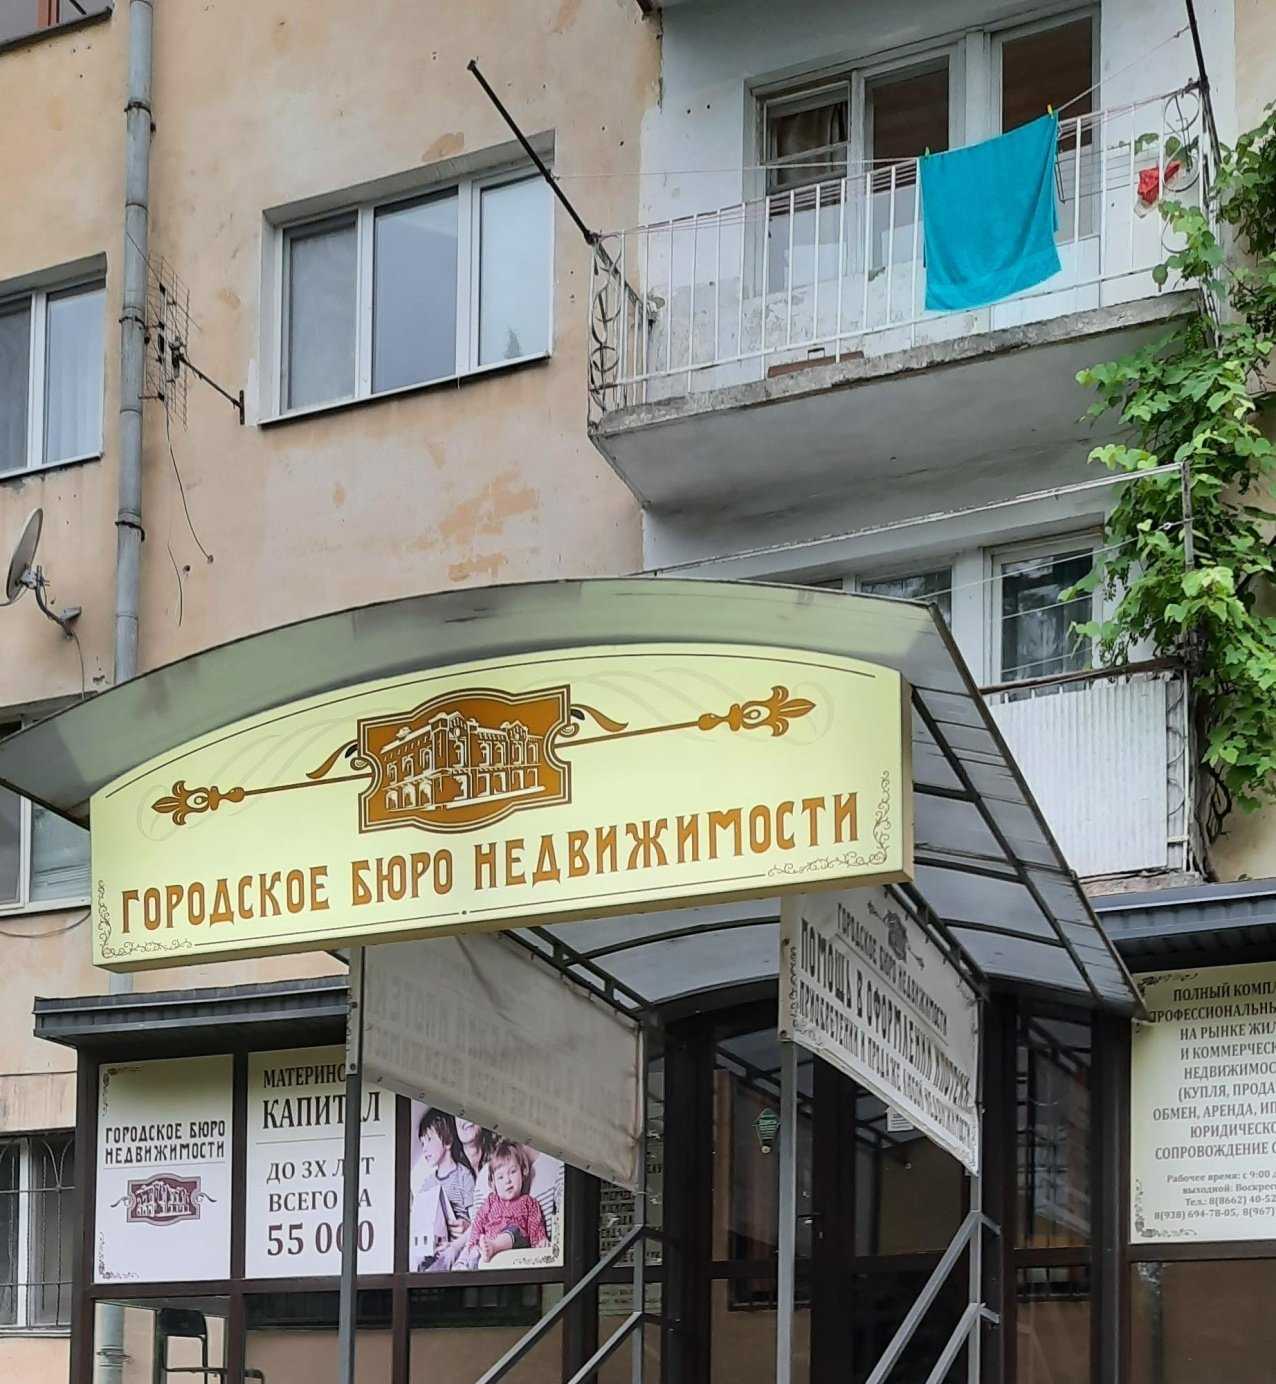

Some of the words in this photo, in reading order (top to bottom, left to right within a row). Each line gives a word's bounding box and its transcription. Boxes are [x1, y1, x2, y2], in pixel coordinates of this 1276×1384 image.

[121, 864, 331, 934] ГОРОДСКОЕ
[351, 847, 453, 906] БЮРО
[473, 791, 860, 890] НЕДВИЖИМОСТИ
[800, 917, 852, 1010] ПОМОЩЬ
[857, 969, 863, 1018] В
[867, 980, 932, 1081] ОФОРМЛЕНИИ
[1173, 982, 1231, 1002] ПОЛНЫЙ
[799, 980, 858, 1058] ПРИОБРЕТЕНИИ
[1180, 1028, 1197, 1040] НА
[1201, 1023, 1246, 1039] РЫНКЕ
[1180, 1047, 1189, 1060] И
[1184, 1061, 1276, 1081] НЕДВИЖИМОС
[1178, 1084, 1230, 1102] (КУПЛЯ,
[263, 1092, 380, 1129] КАПИТЛ
[1153, 1106, 1200, 1121] ОБМЕН,
[1203, 1102, 1257, 1119] АРЕНДА,
[105, 1123, 182, 1144] ГОРОДСКОЕ
[190, 1120, 225, 1139] БЮРО
[105, 1141, 225, 1165] НЕДВИЖИМОСТИ
[1155, 1141, 1269, 1160] СОПРОВОЖДЕНИЕ
[267, 1161, 295, 1184] ДО
[332, 1157, 375, 1177] ЛТ
[1167, 1174, 1206, 1183] Рабочее
[1249, 1170, 1271, 1179] 9:00
[269, 1190, 338, 1212] ВСЕГО
[267, 1222, 304, 1256] 55
